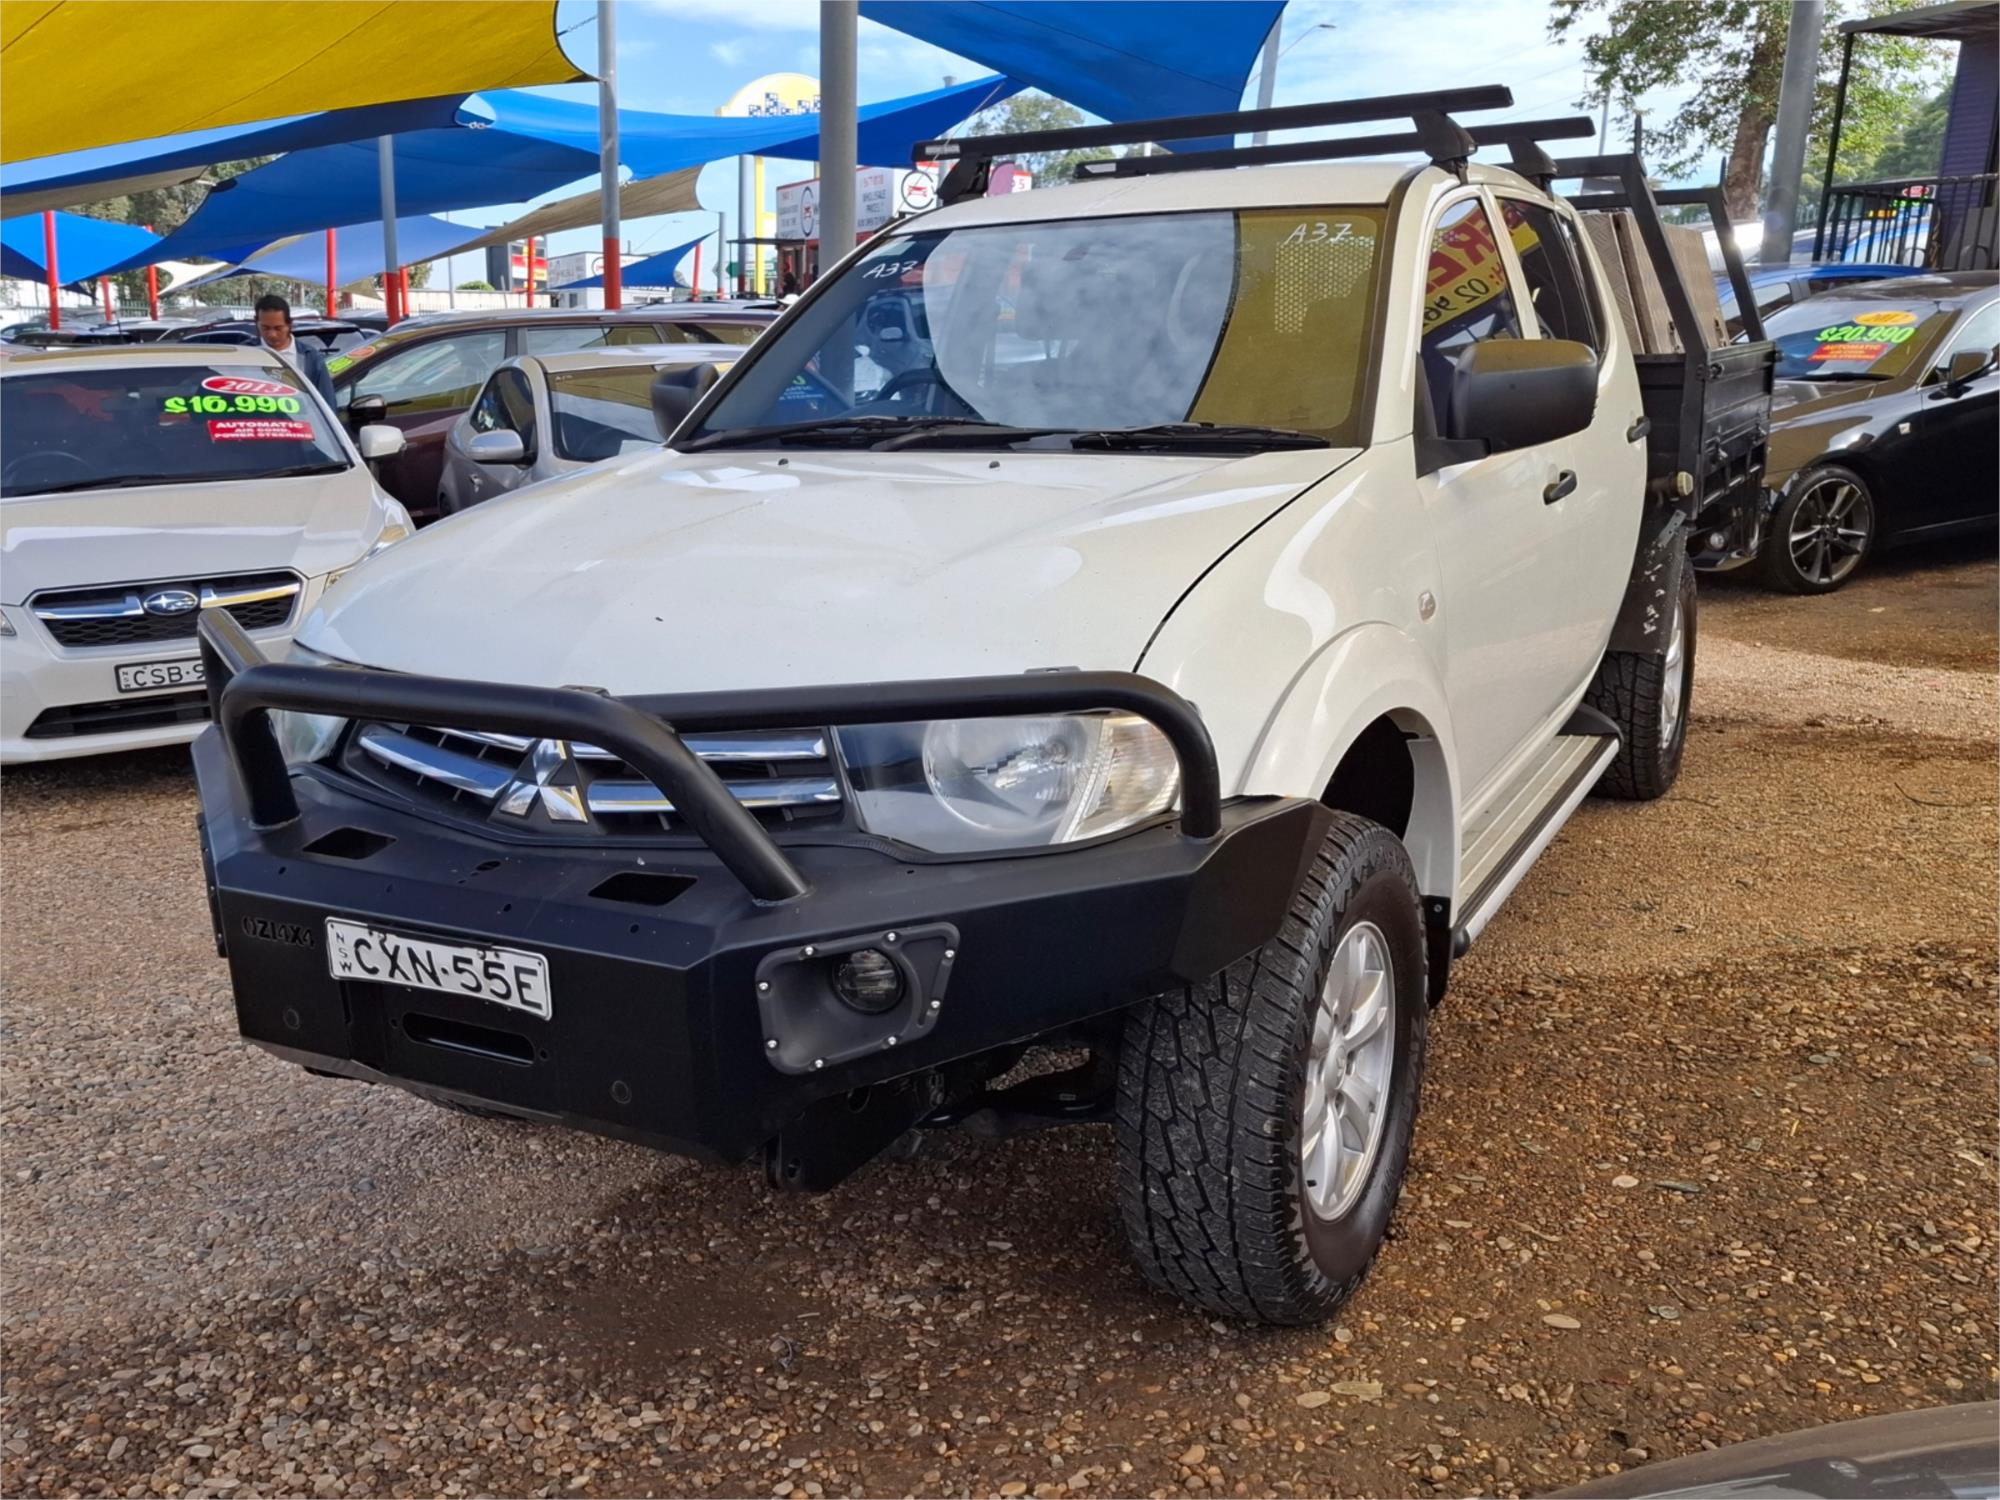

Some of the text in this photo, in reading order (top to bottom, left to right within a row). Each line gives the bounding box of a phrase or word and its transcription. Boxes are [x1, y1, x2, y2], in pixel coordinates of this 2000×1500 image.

[862, 260, 918, 278] A37
[1815, 326, 1915, 343] $20.990
[219, 380, 283, 393] 2013
